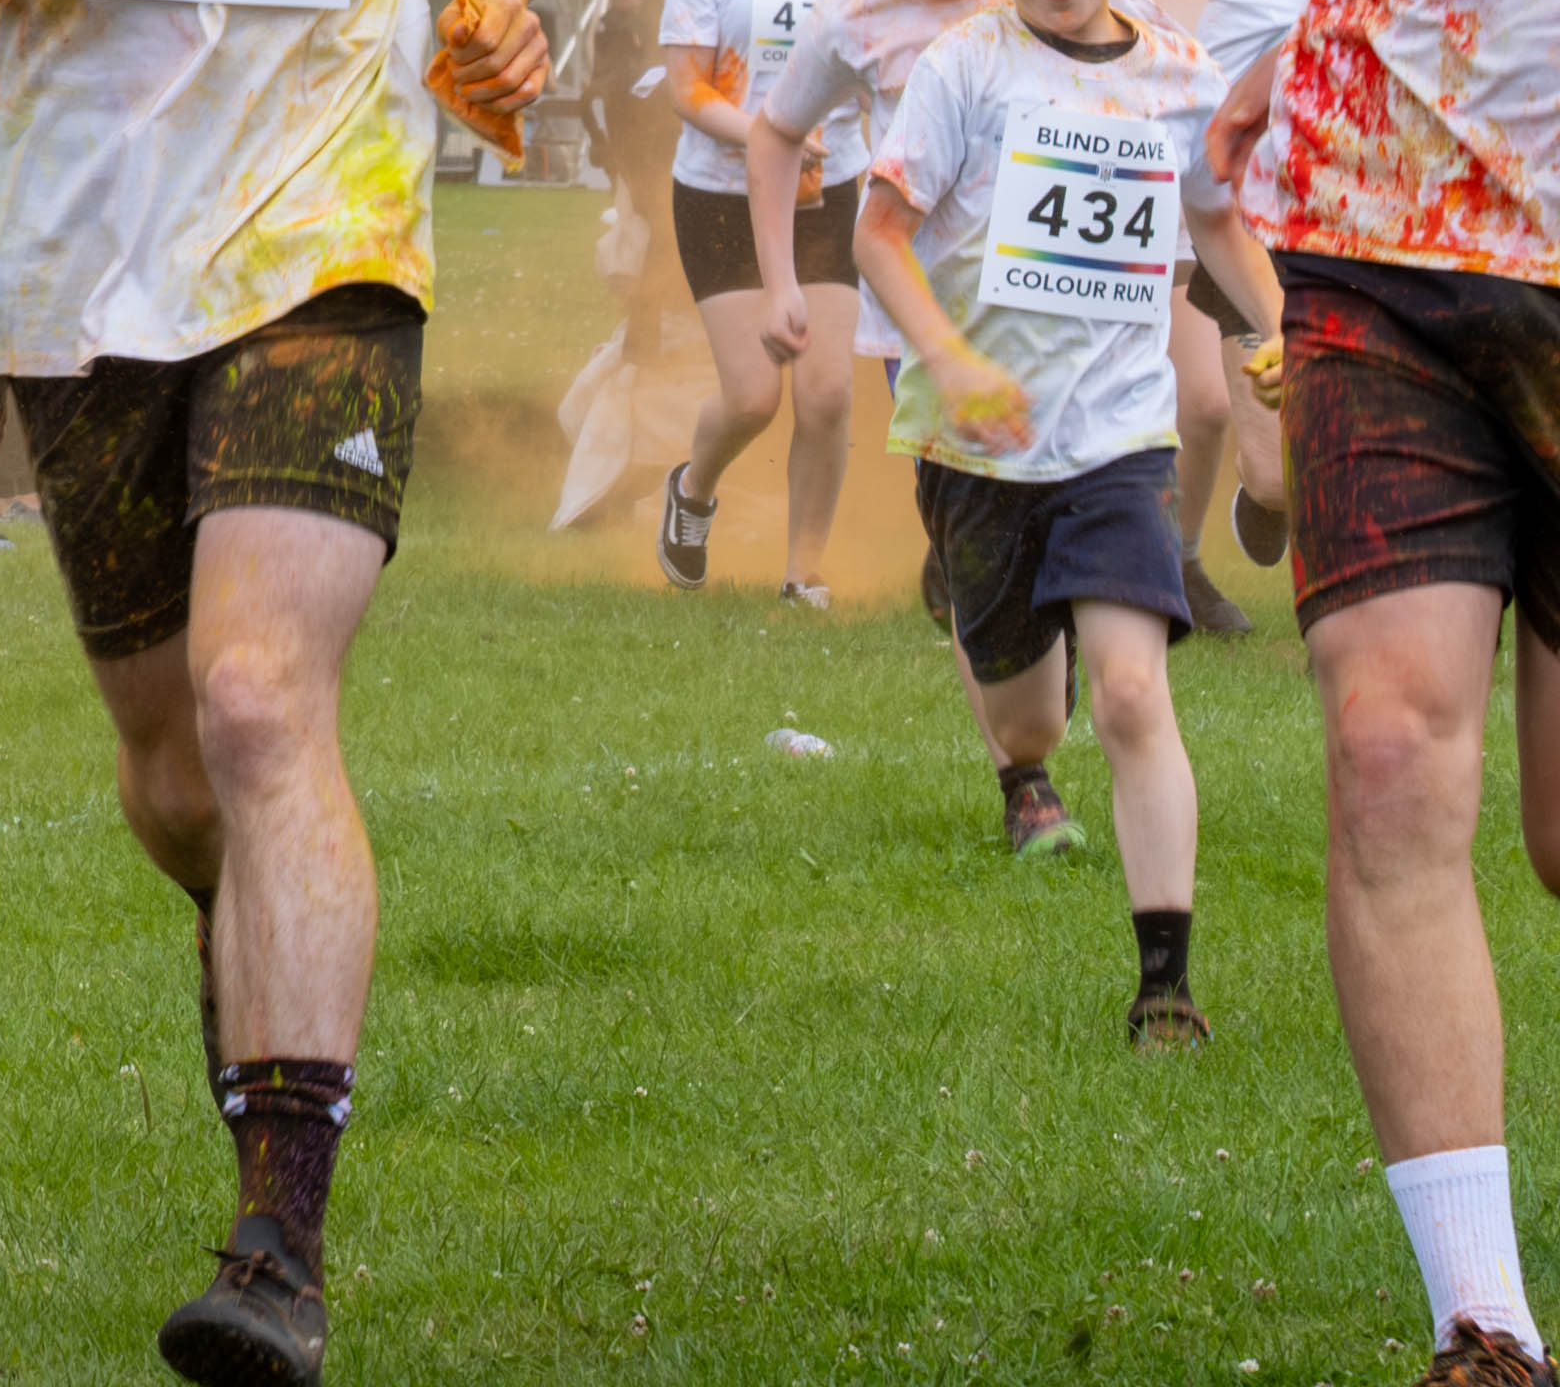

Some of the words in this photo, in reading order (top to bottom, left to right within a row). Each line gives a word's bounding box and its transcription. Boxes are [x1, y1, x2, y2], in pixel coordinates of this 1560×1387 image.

[1037, 127, 1110, 155] BLIND
[1117, 139, 1165, 161] DAVE
[1027, 184, 1156, 250] 434
[1006, 267, 1107, 300] COLOUR
[1113, 284, 1154, 304] RUN
